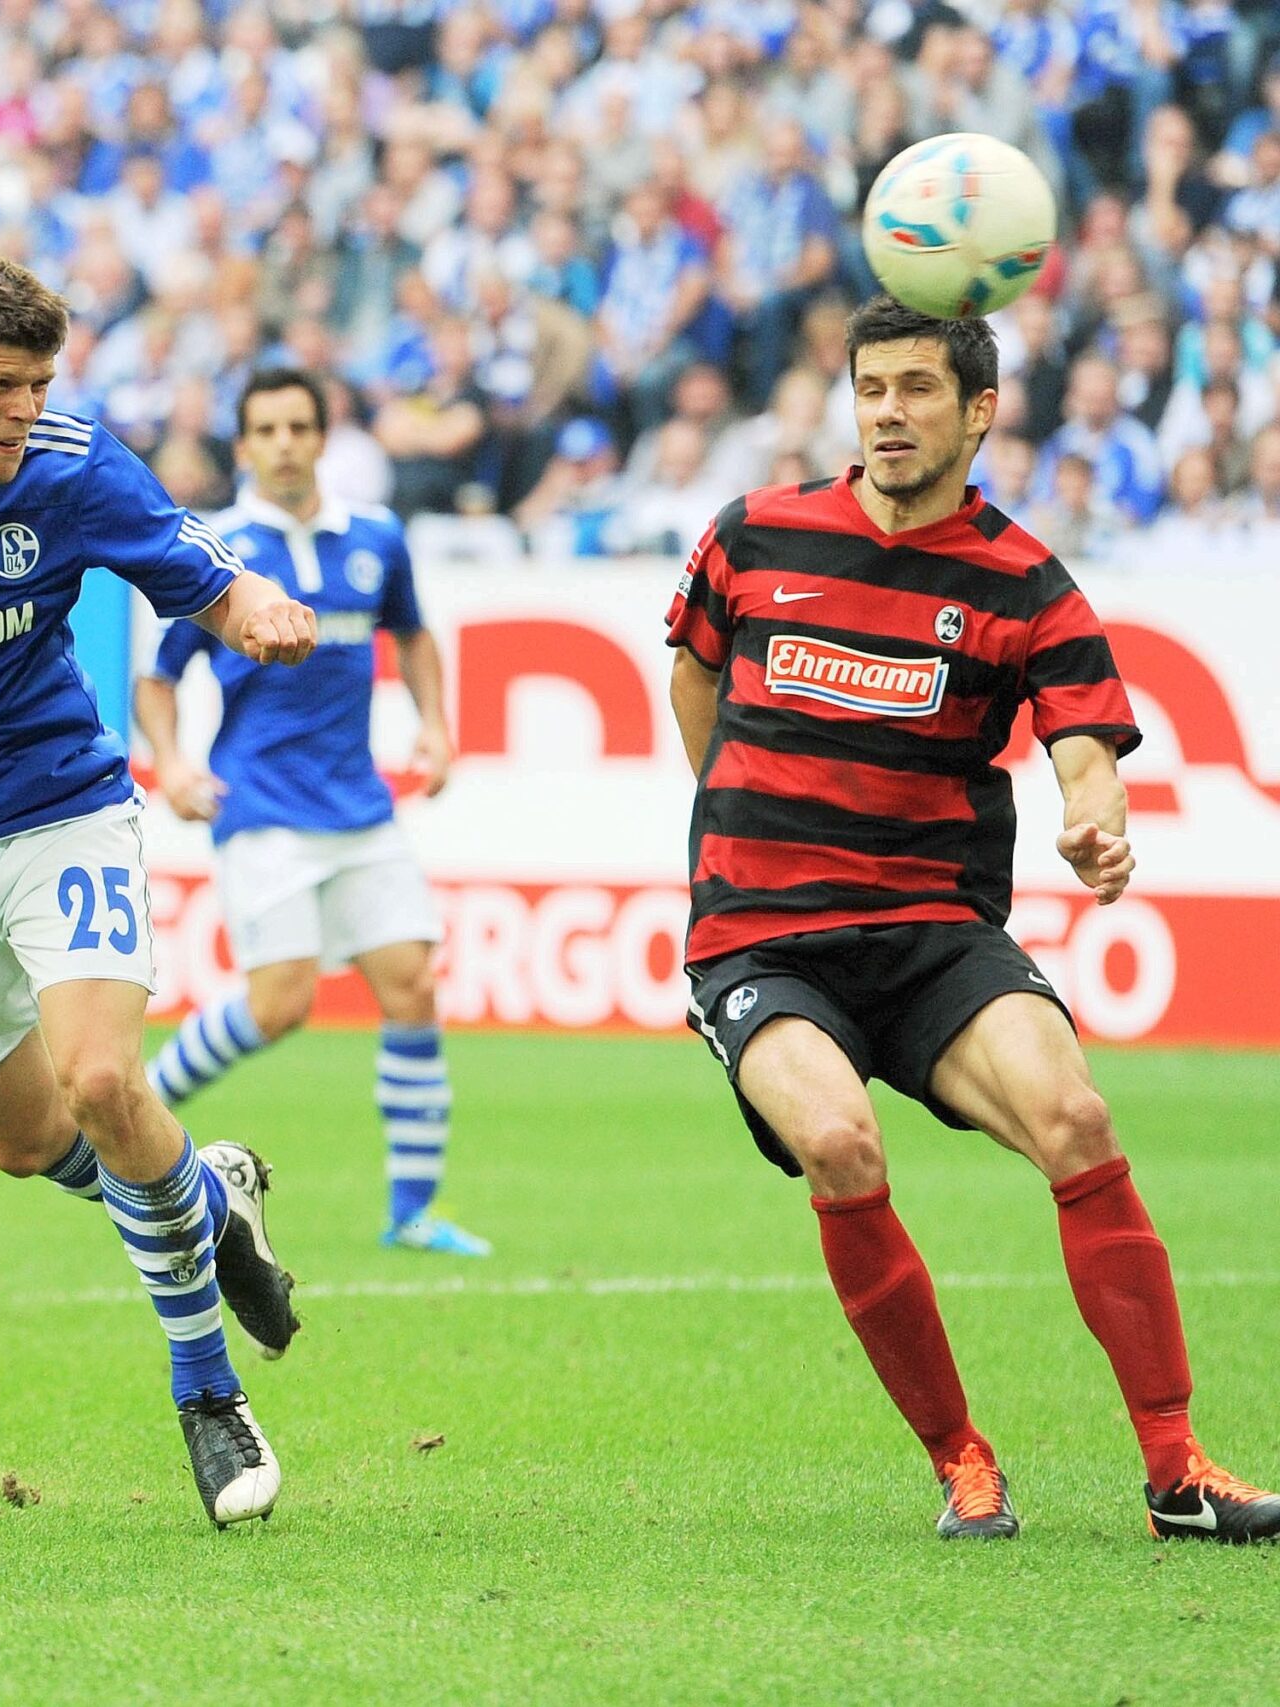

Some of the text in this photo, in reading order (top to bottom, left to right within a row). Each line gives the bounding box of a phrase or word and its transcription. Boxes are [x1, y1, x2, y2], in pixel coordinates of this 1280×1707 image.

[772, 643, 933, 697] Ehrmann
[57, 866, 138, 955] 25
[433, 887, 688, 1028] RGO
